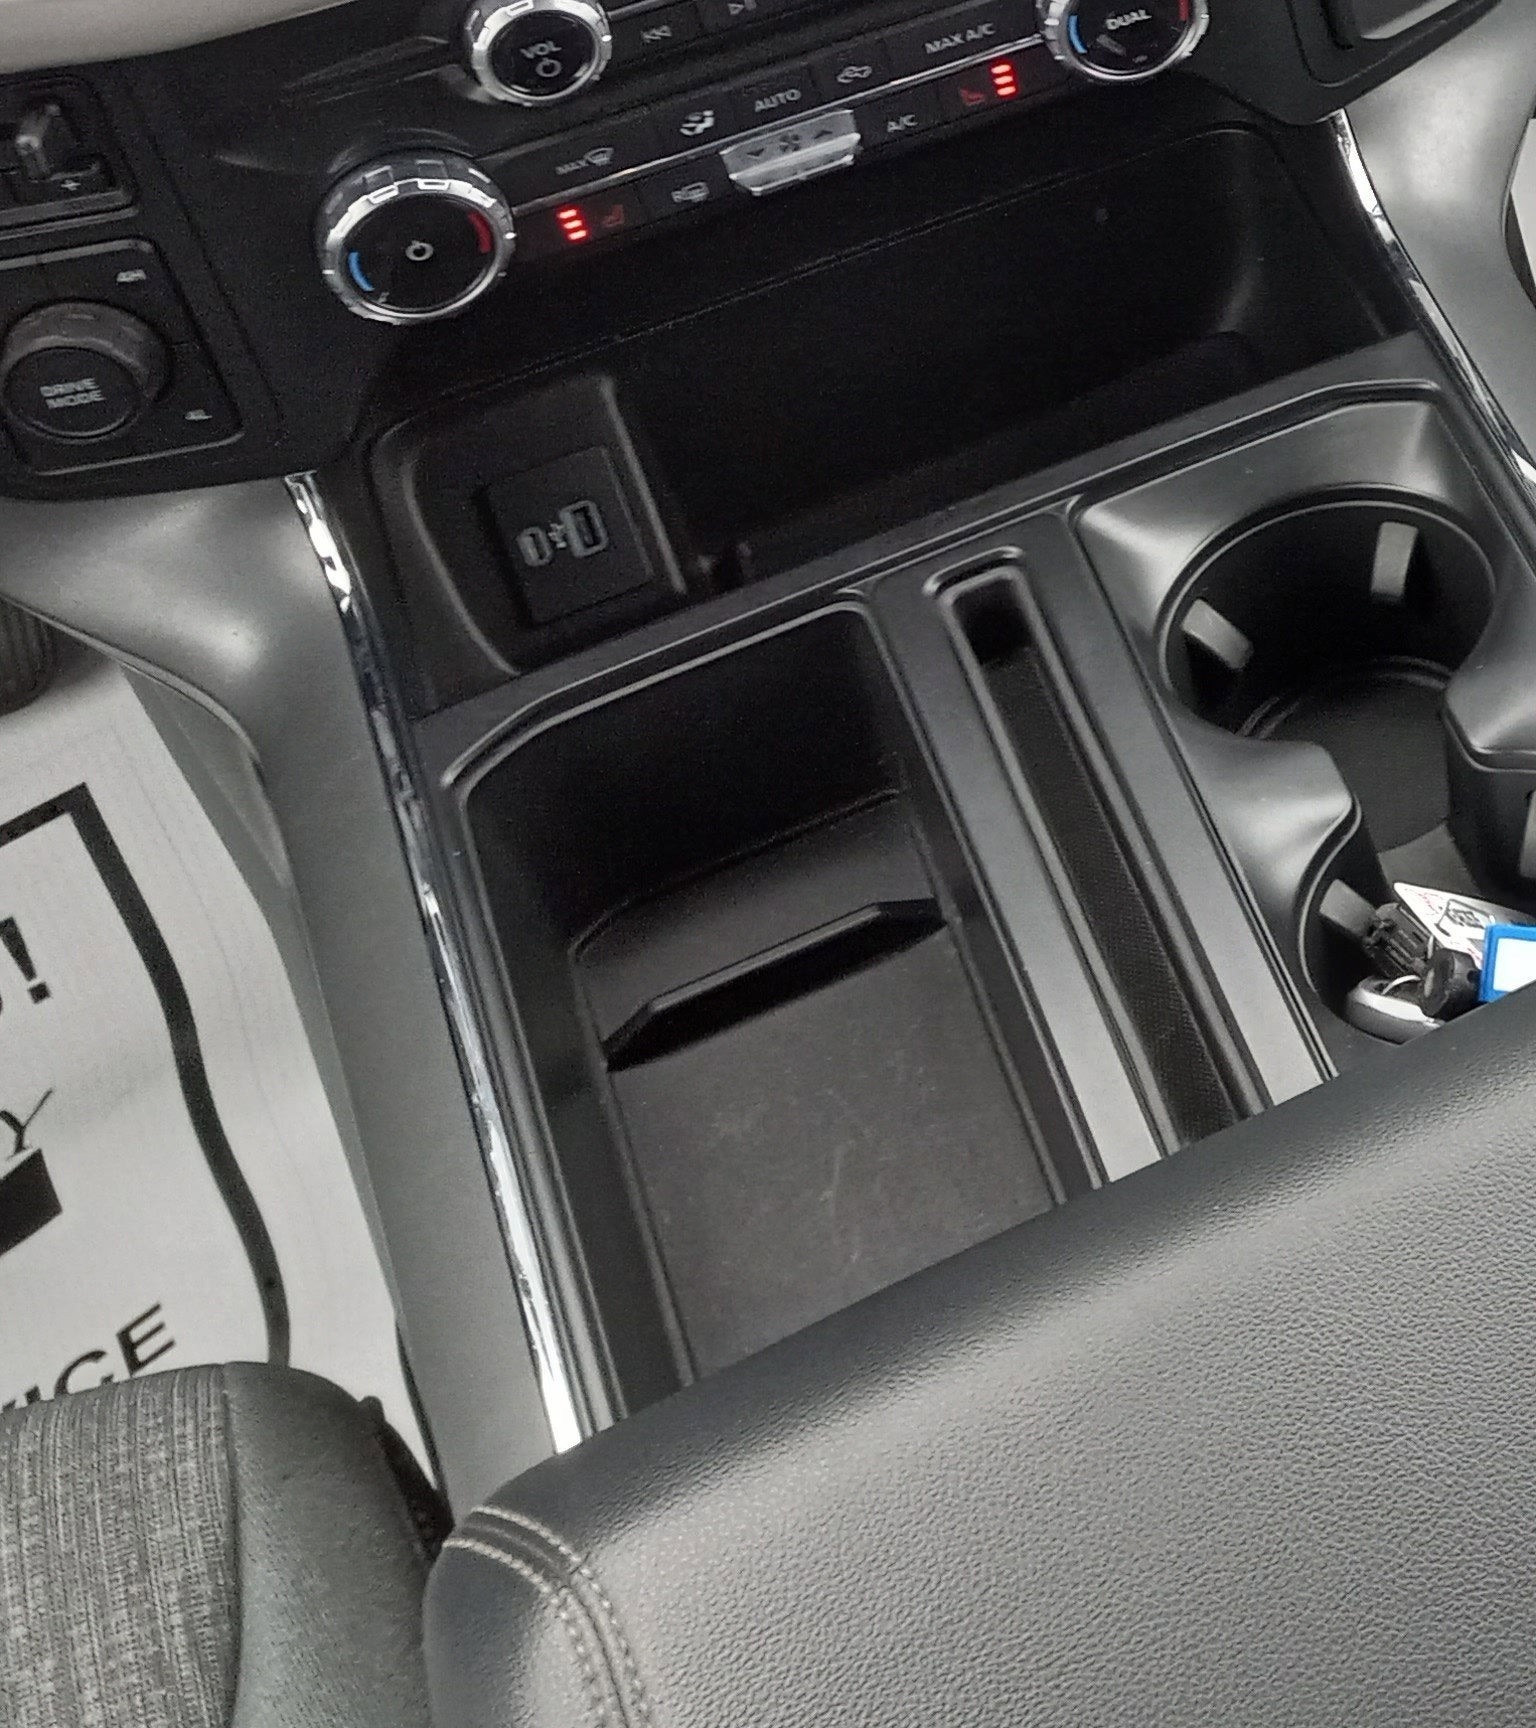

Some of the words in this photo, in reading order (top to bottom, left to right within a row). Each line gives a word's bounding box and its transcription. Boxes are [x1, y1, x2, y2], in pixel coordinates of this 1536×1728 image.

[1105, 8, 1152, 32] DUAL
[924, 32, 965, 55] MAX
[965, 22, 997, 42] A/C
[521, 39, 562, 61] VOL
[754, 88, 802, 112] AUTO
[886, 113, 920, 135] A/C
[39, 377, 99, 398] DRIVE
[45, 389, 107, 409] MODE
